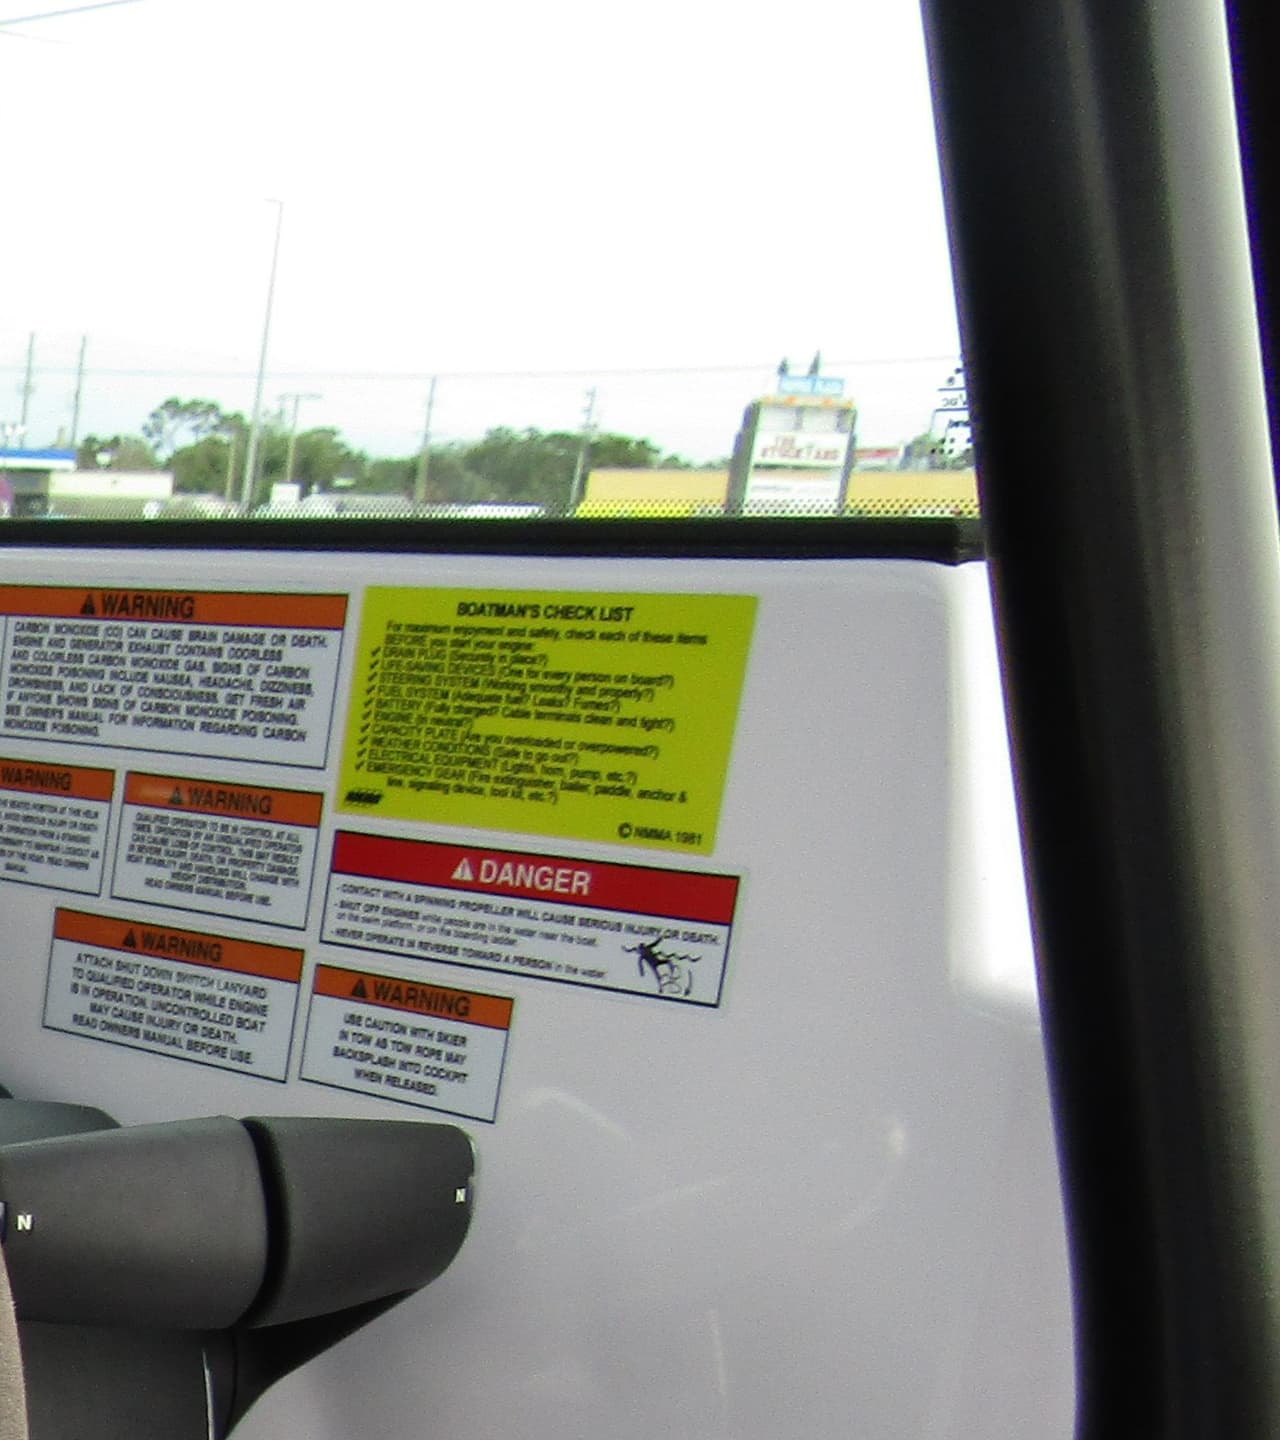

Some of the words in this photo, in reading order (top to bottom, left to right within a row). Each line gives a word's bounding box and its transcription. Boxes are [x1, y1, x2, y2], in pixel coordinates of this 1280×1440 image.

[99, 593, 197, 619] WARNING
[457, 601, 541, 619] BOATMAN'S
[542, 604, 596, 621] CHECK
[597, 605, 633, 622] LIST
[126, 626, 146, 639] CAN
[227, 647, 283, 662] ODORLESS
[90, 682, 116, 696] LACK
[107, 712, 127, 725] FOR
[0, 764, 72, 791] WARNING
[186, 786, 273, 815] WARNING
[633, 826, 672, 842] NMMA
[675, 830, 702, 846] 1981
[340, 882, 381, 898] CONTACT
[477, 858, 592, 897] DANGER
[139, 930, 223, 963] WARNING
[75, 951, 113, 969] ATTACH
[114, 959, 140, 975] SHUT
[142, 964, 173, 982] DOWN
[175, 970, 215, 989] SWITCH
[215, 978, 268, 1000] LANYARD
[85, 969, 135, 990] QUALIFIED
[136, 979, 192, 1002] OPERATOR
[192, 991, 226, 1009] WHILE
[227, 997, 268, 1017] ENGINE
[371, 980, 471, 1018] WARNING
[88, 1001, 110, 1016] MAY
[110, 1006, 144, 1024] CAUSE
[145, 1013, 181, 1032] INJURY
[151, 998, 234, 1027] UNCONTROLLED
[234, 1015, 265, 1033] BOAT
[71, 1013, 98, 1030] READ
[98, 1019, 140, 1039] OWNERS
[142, 1029, 183, 1049] MANUAL
[185, 1038, 228, 1059] BEFORE
[343, 1012, 362, 1027] USE
[363, 1016, 408, 1035] CAUTION
[409, 1025, 434, 1041] WITH
[435, 1031, 467, 1048] SKIER
[350, 1031, 372, 1046] TOW
[390, 1039, 412, 1054] TOW
[414, 1044, 443, 1061] ROPE
[444, 1050, 466, 1066] MAY
[332, 1045, 396, 1069] BACKSPLASH
[397, 1059, 421, 1074] INTO
[422, 1064, 468, 1084] COCKPIT
[353, 1067, 382, 1084] WHEN
[455, 1186, 467, 1203] N
[16, 1214, 34, 1232] N
